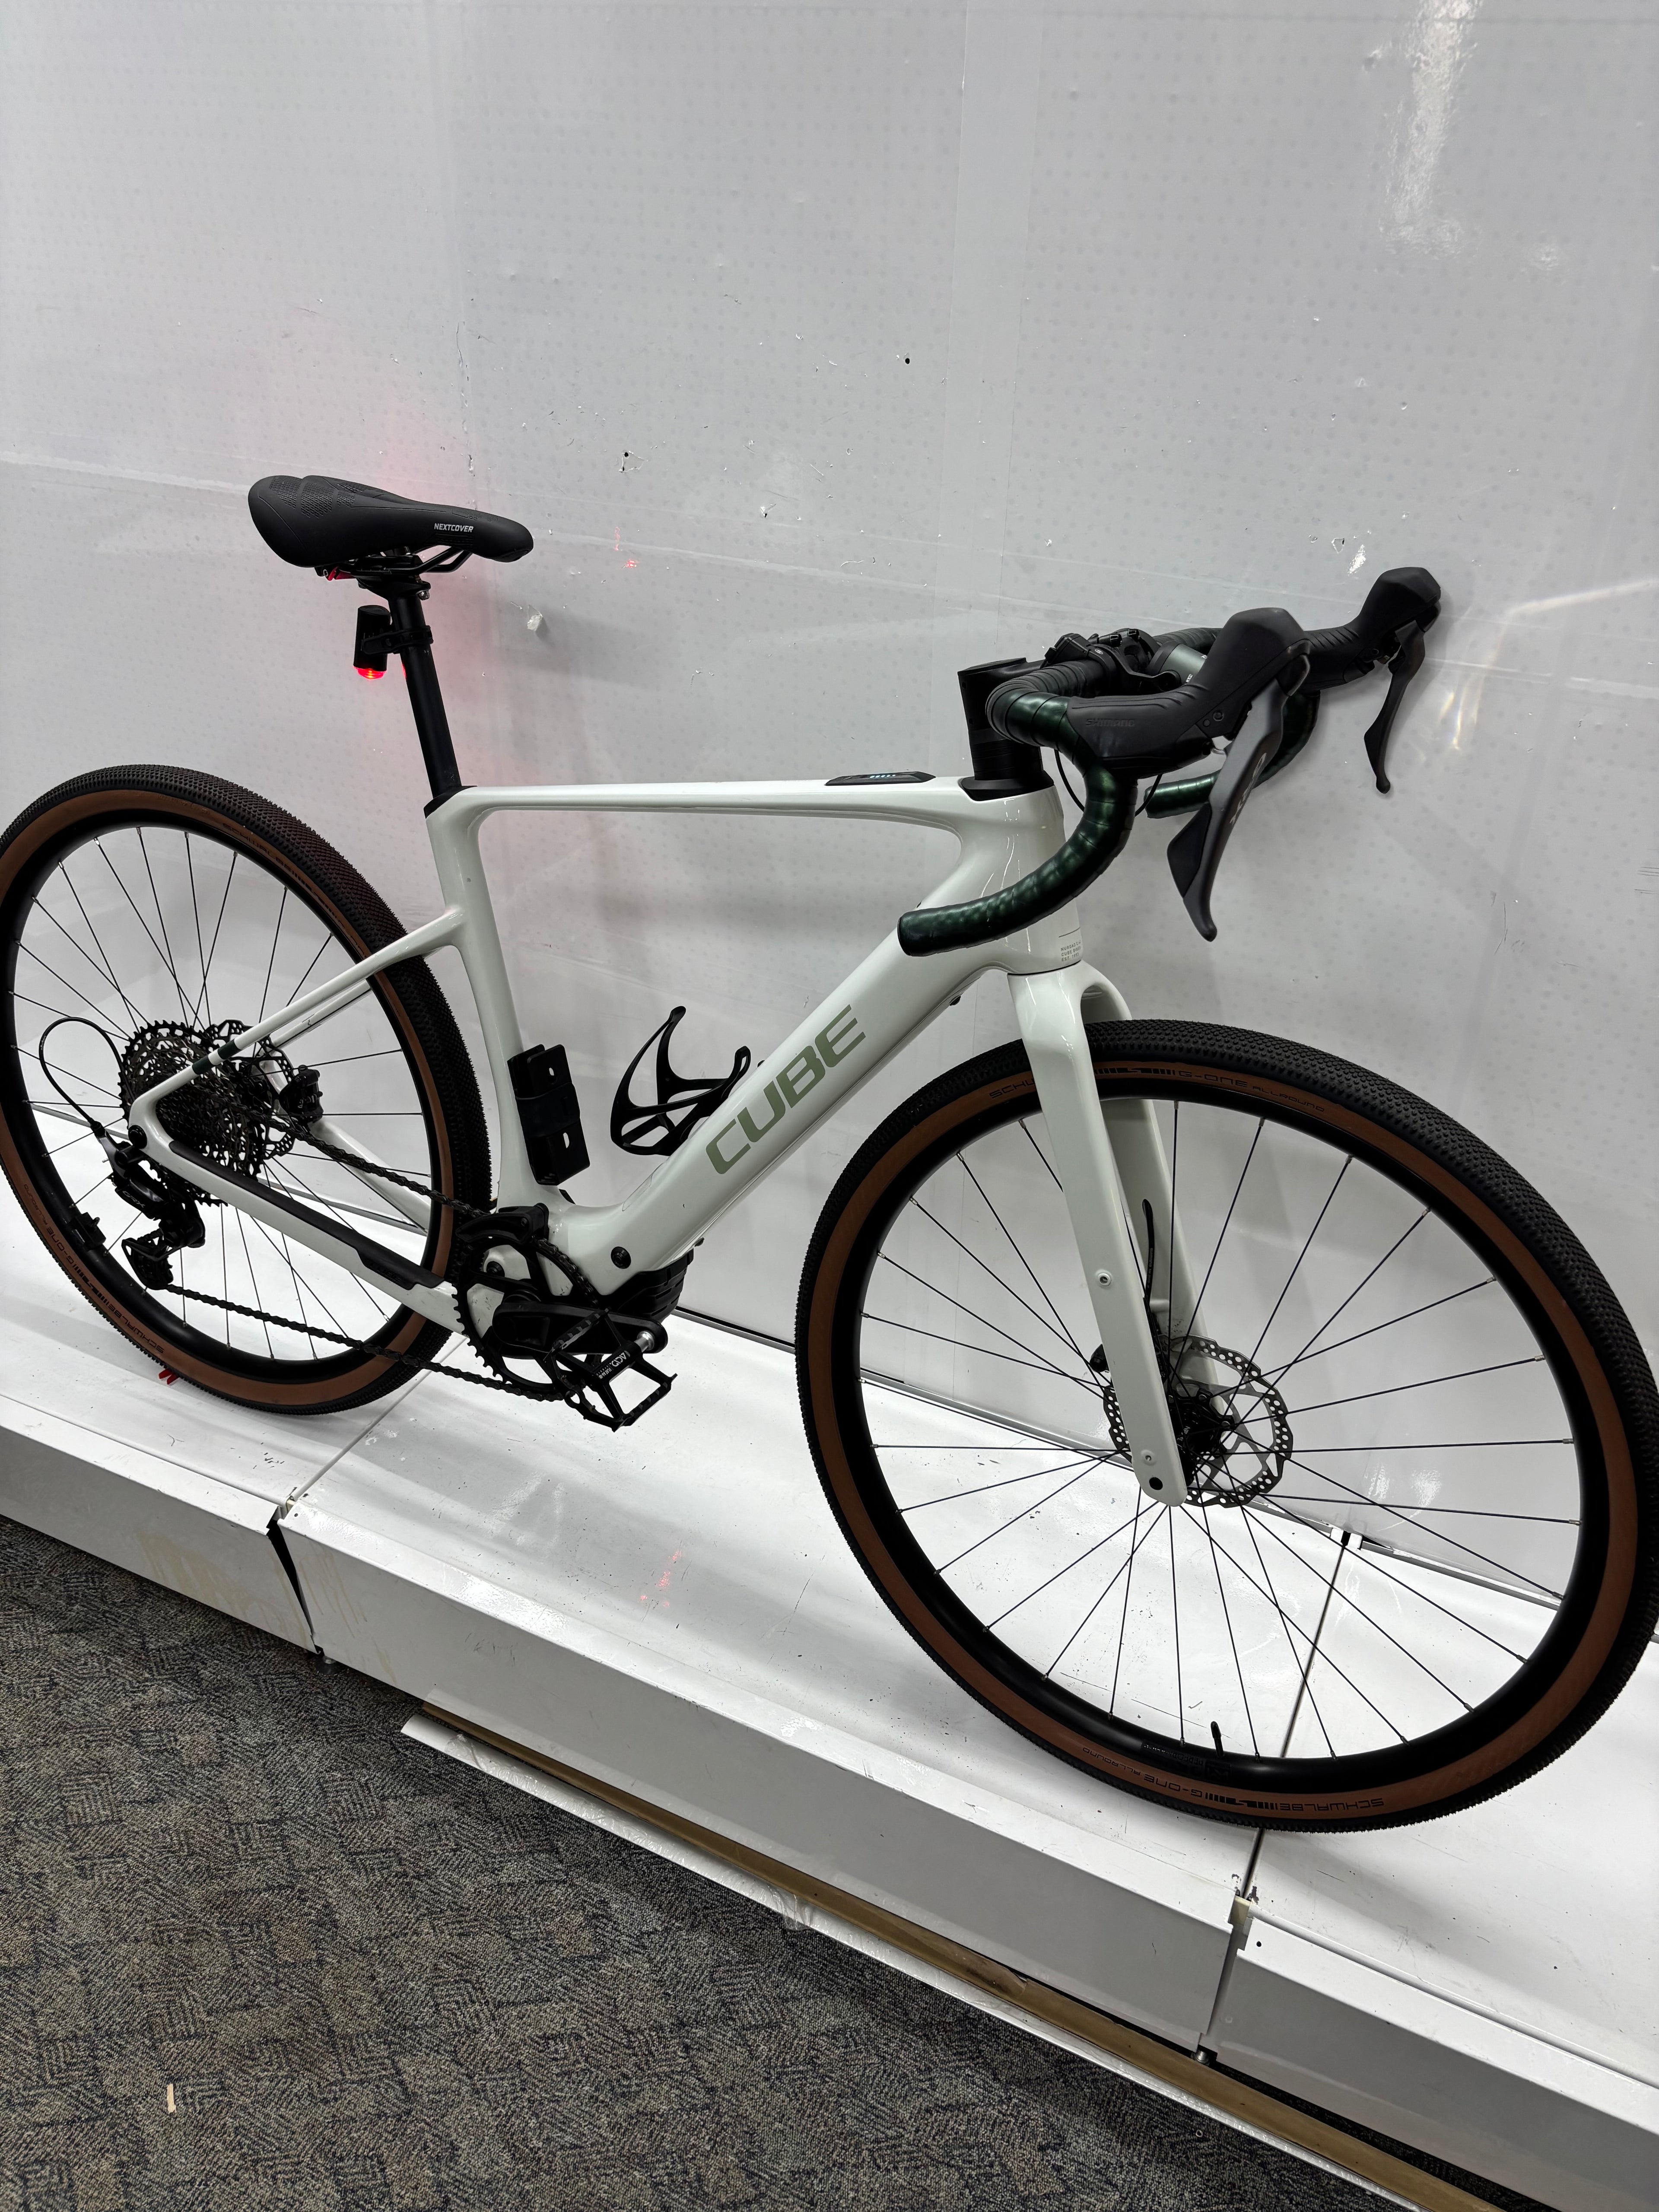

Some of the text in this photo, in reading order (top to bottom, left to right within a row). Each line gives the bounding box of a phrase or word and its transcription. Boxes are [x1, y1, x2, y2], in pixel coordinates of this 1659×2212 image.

[434, 523, 474, 532] NEXTCOVER
[706, 1004, 866, 1174] CUBE
[1179, 1071, 1325, 1112] G-ONE ALLROUND
[122, 1190, 146, 1208] GRX
[46, 1225, 74, 1265] G-ONE
[108, 1304, 165, 1354] SCHWALBE
[1083, 1747, 1202, 1798] G-ONE ALLROUND
[1280, 1798, 1384, 1811] SCHWALBE
